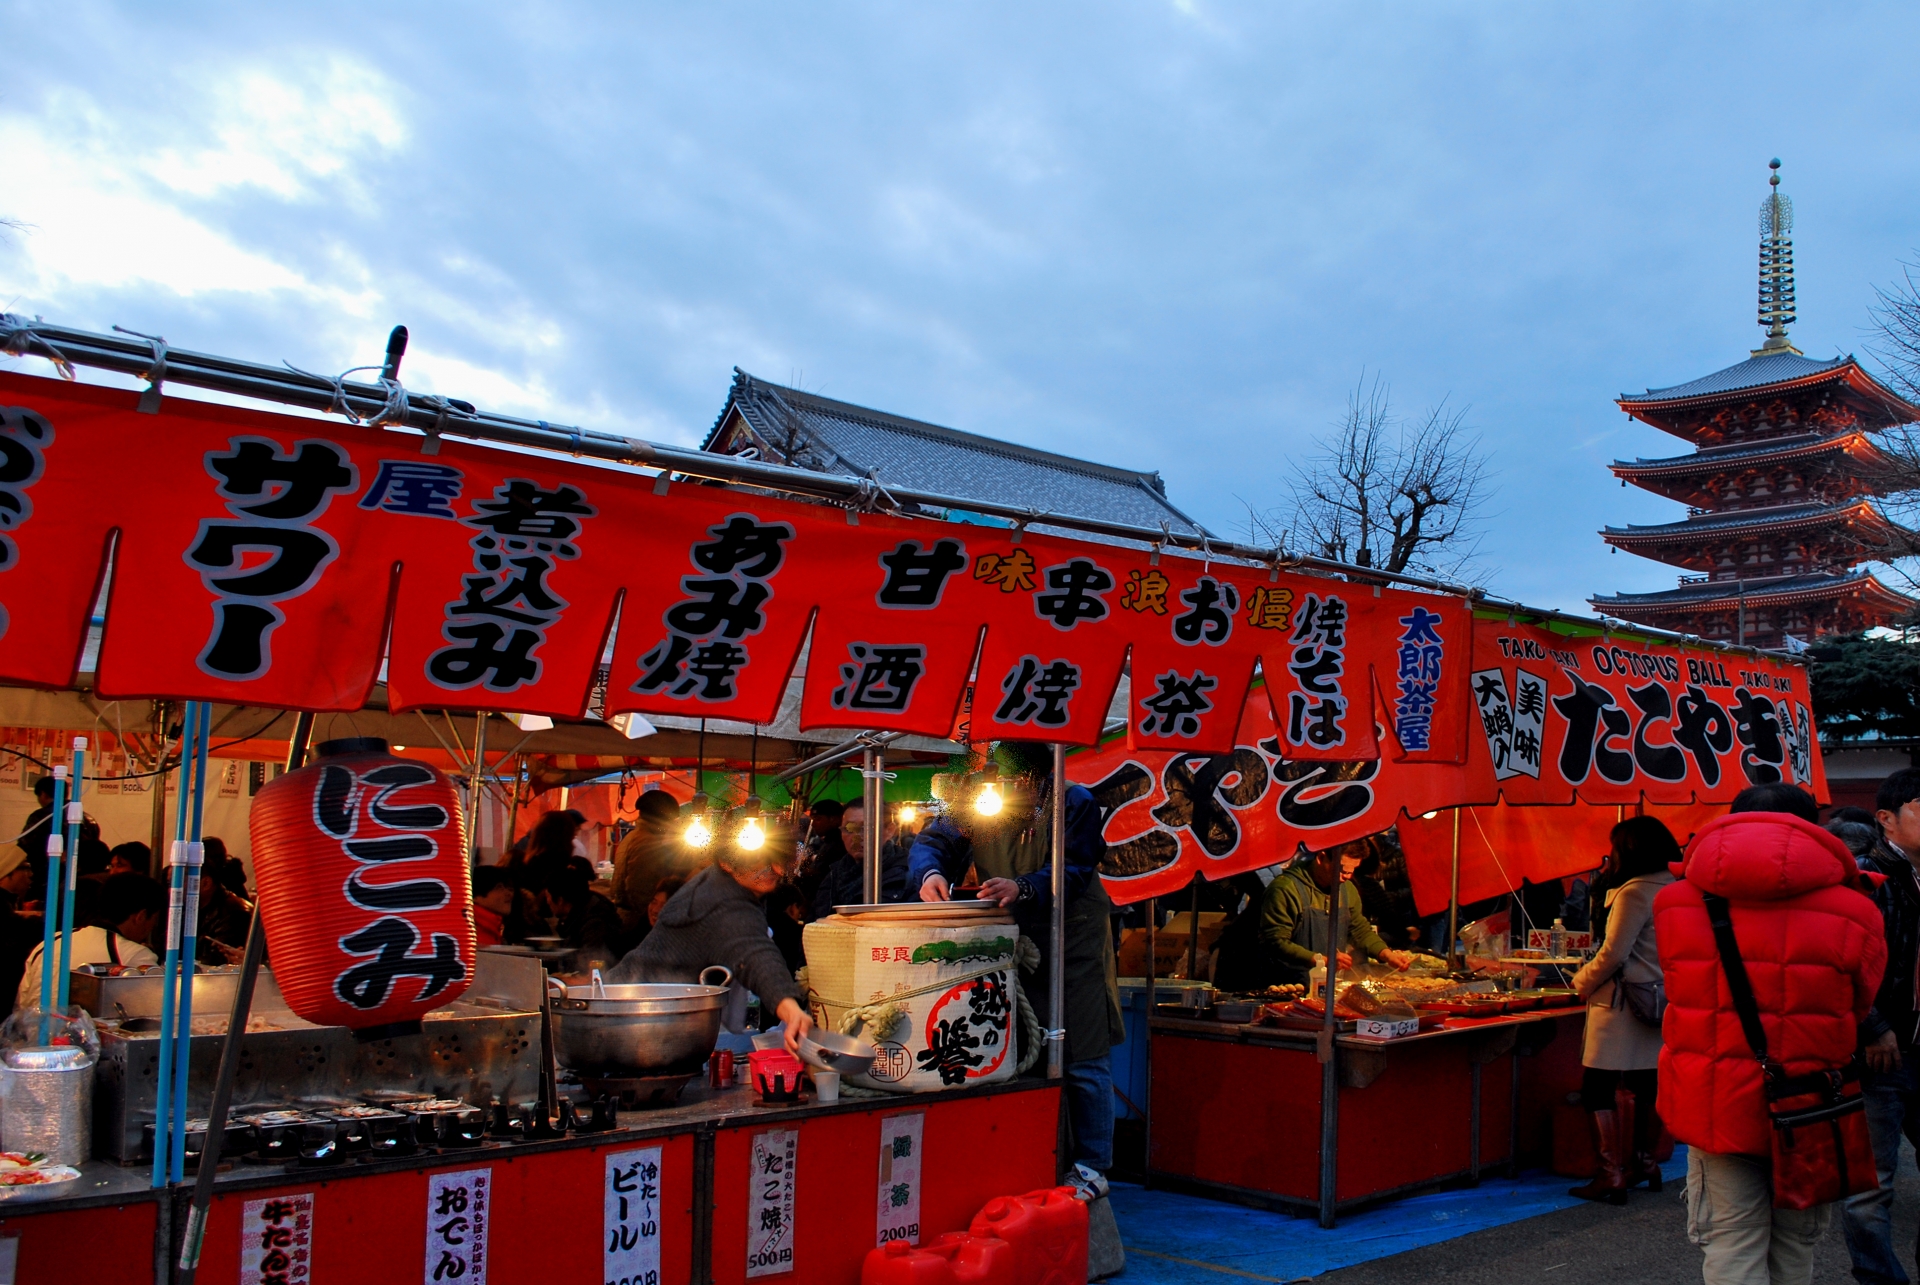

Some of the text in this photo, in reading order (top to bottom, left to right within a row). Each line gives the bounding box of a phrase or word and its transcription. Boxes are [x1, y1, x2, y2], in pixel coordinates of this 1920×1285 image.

[358, 460, 463, 519] 屋
[184, 436, 359, 680] サワー
[424, 478, 598, 692] 煮込み
[973, 548, 1037, 593] 味
[1120, 570, 1169, 616] 浪
[631, 512, 796, 701] あみ焼
[831, 538, 969, 712] 甘酒
[994, 556, 1115, 729] 串焼
[1497, 636, 1580, 669] TAKOAKI
[1138, 575, 1240, 739] お茶
[1287, 592, 1348, 749] 焼そば
[1394, 606, 1444, 752] 太郎茶屋
[1591, 645, 1732, 688] OCTOPUS BALL
[1514, 679, 1544, 768] 美味
[1551, 667, 1786, 788] たこやき
[313, 763, 470, 1011] にこみ
[608, 1162, 641, 1253] ビール
[761, 1153, 783, 1231] たこ焼
[891, 1135, 912, 1208] 緑茶
[433, 1187, 470, 1281] おでん
[749, 1247, 792, 1268] 500円
[880, 1223, 919, 1243] 200円
